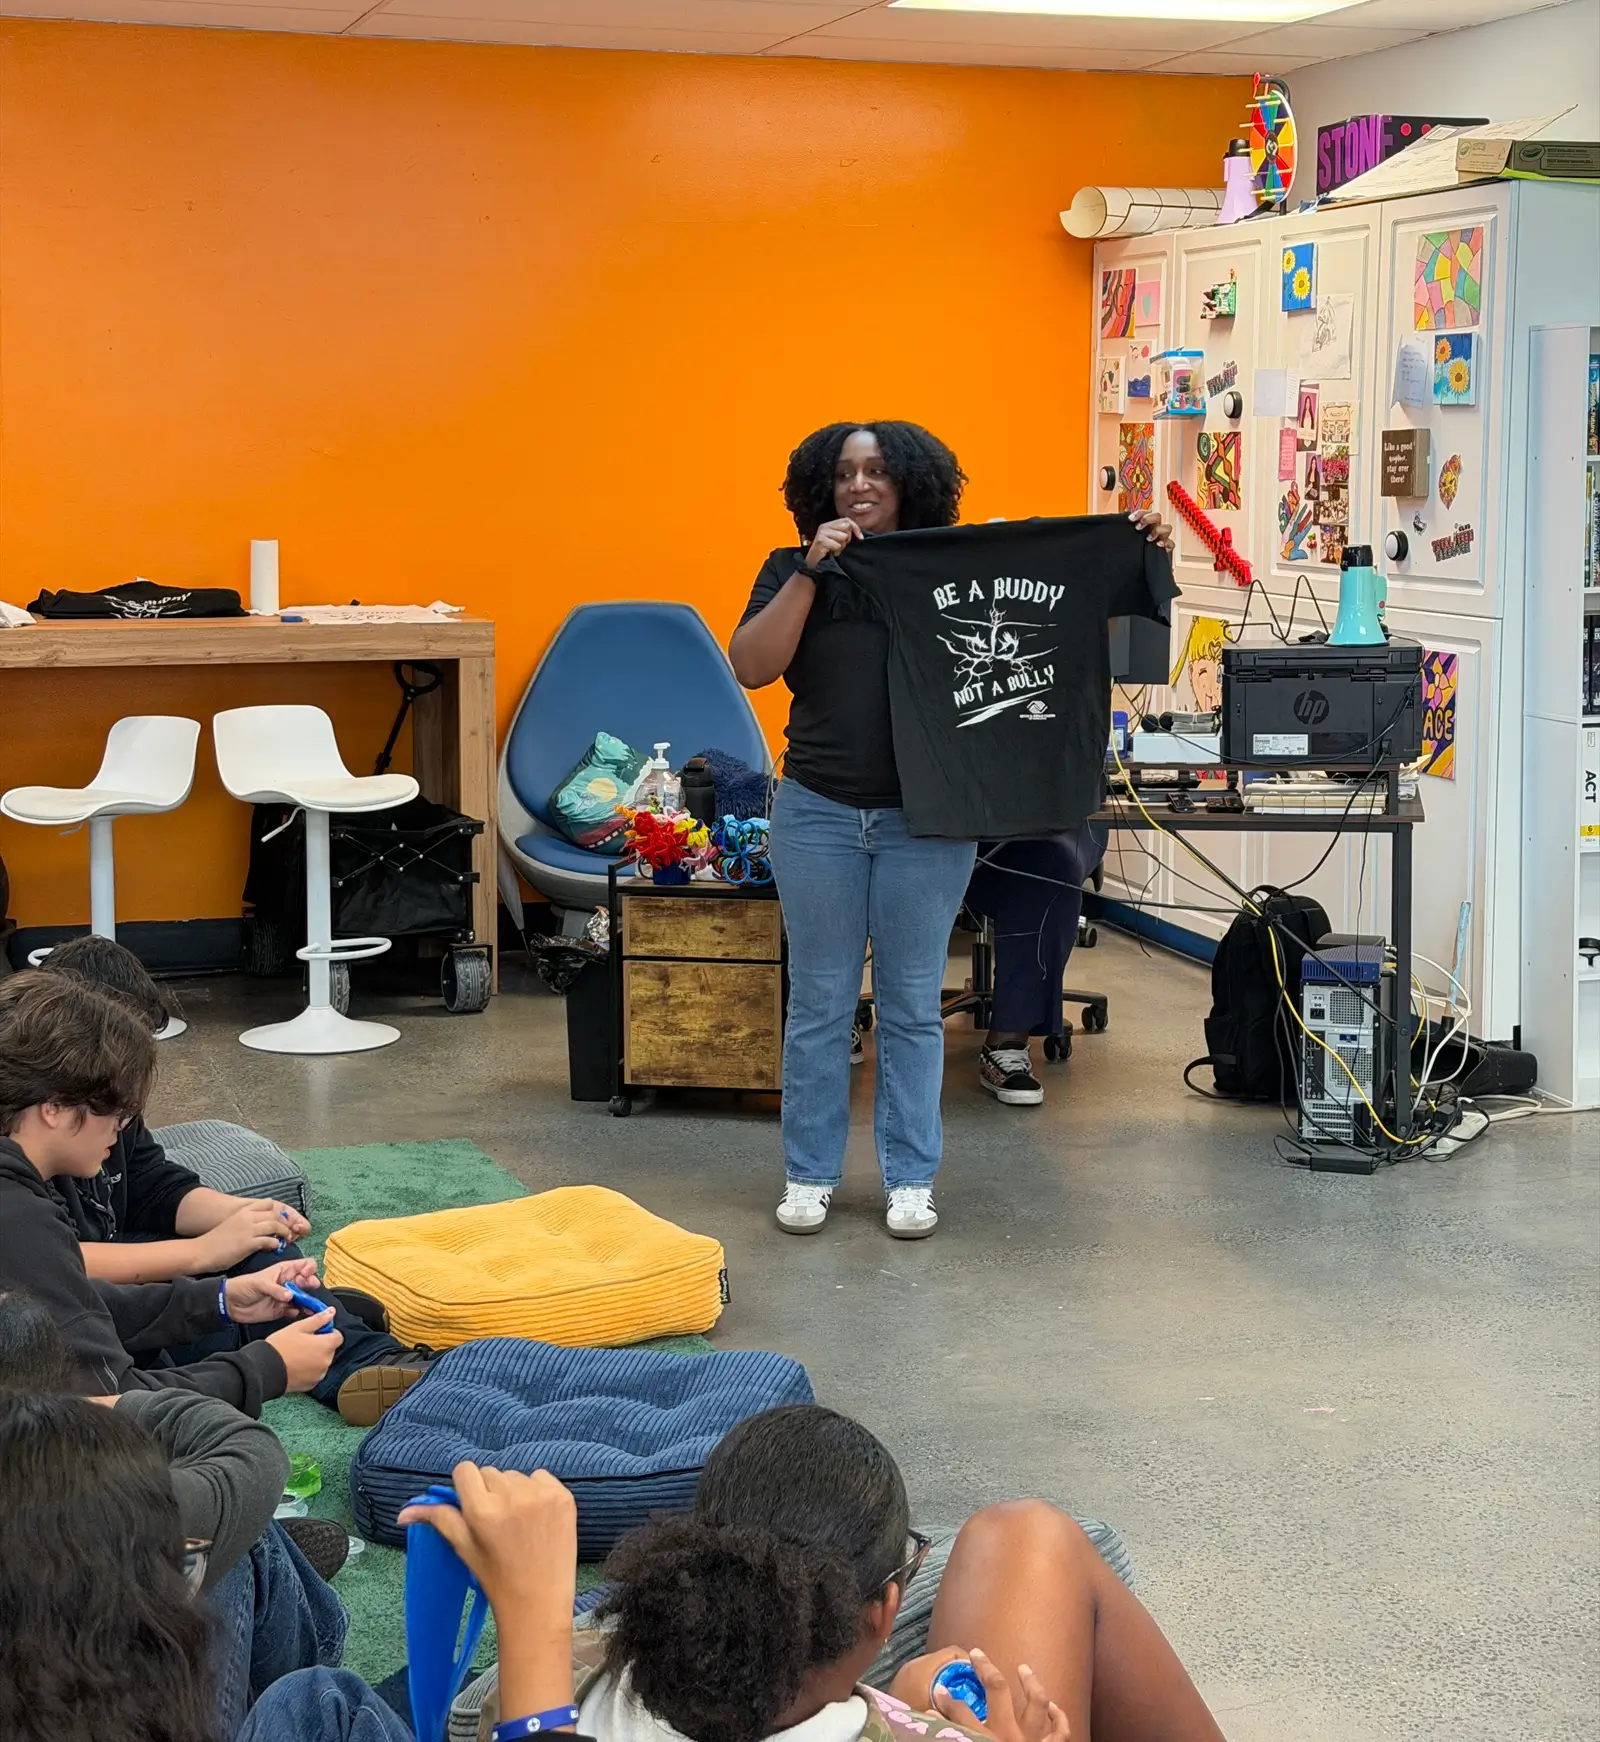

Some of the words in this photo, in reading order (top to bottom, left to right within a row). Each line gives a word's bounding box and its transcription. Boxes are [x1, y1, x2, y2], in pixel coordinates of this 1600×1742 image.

[1319, 114, 1393, 189] STONE
[1384, 442, 1395, 452] Like
[1400, 442, 1413, 452] good
[1386, 465, 1397, 474] stay
[1390, 475, 1405, 484] there!
[932, 582, 960, 610] BE
[968, 580, 985, 602] A
[994, 577, 1065, 612] BUDDY
[953, 681, 985, 708] NOT
[992, 680, 1004, 696] A
[1007, 664, 1055, 691] BULLY
[1297, 691, 1327, 724] hp
[1585, 770, 1597, 803] ACT
